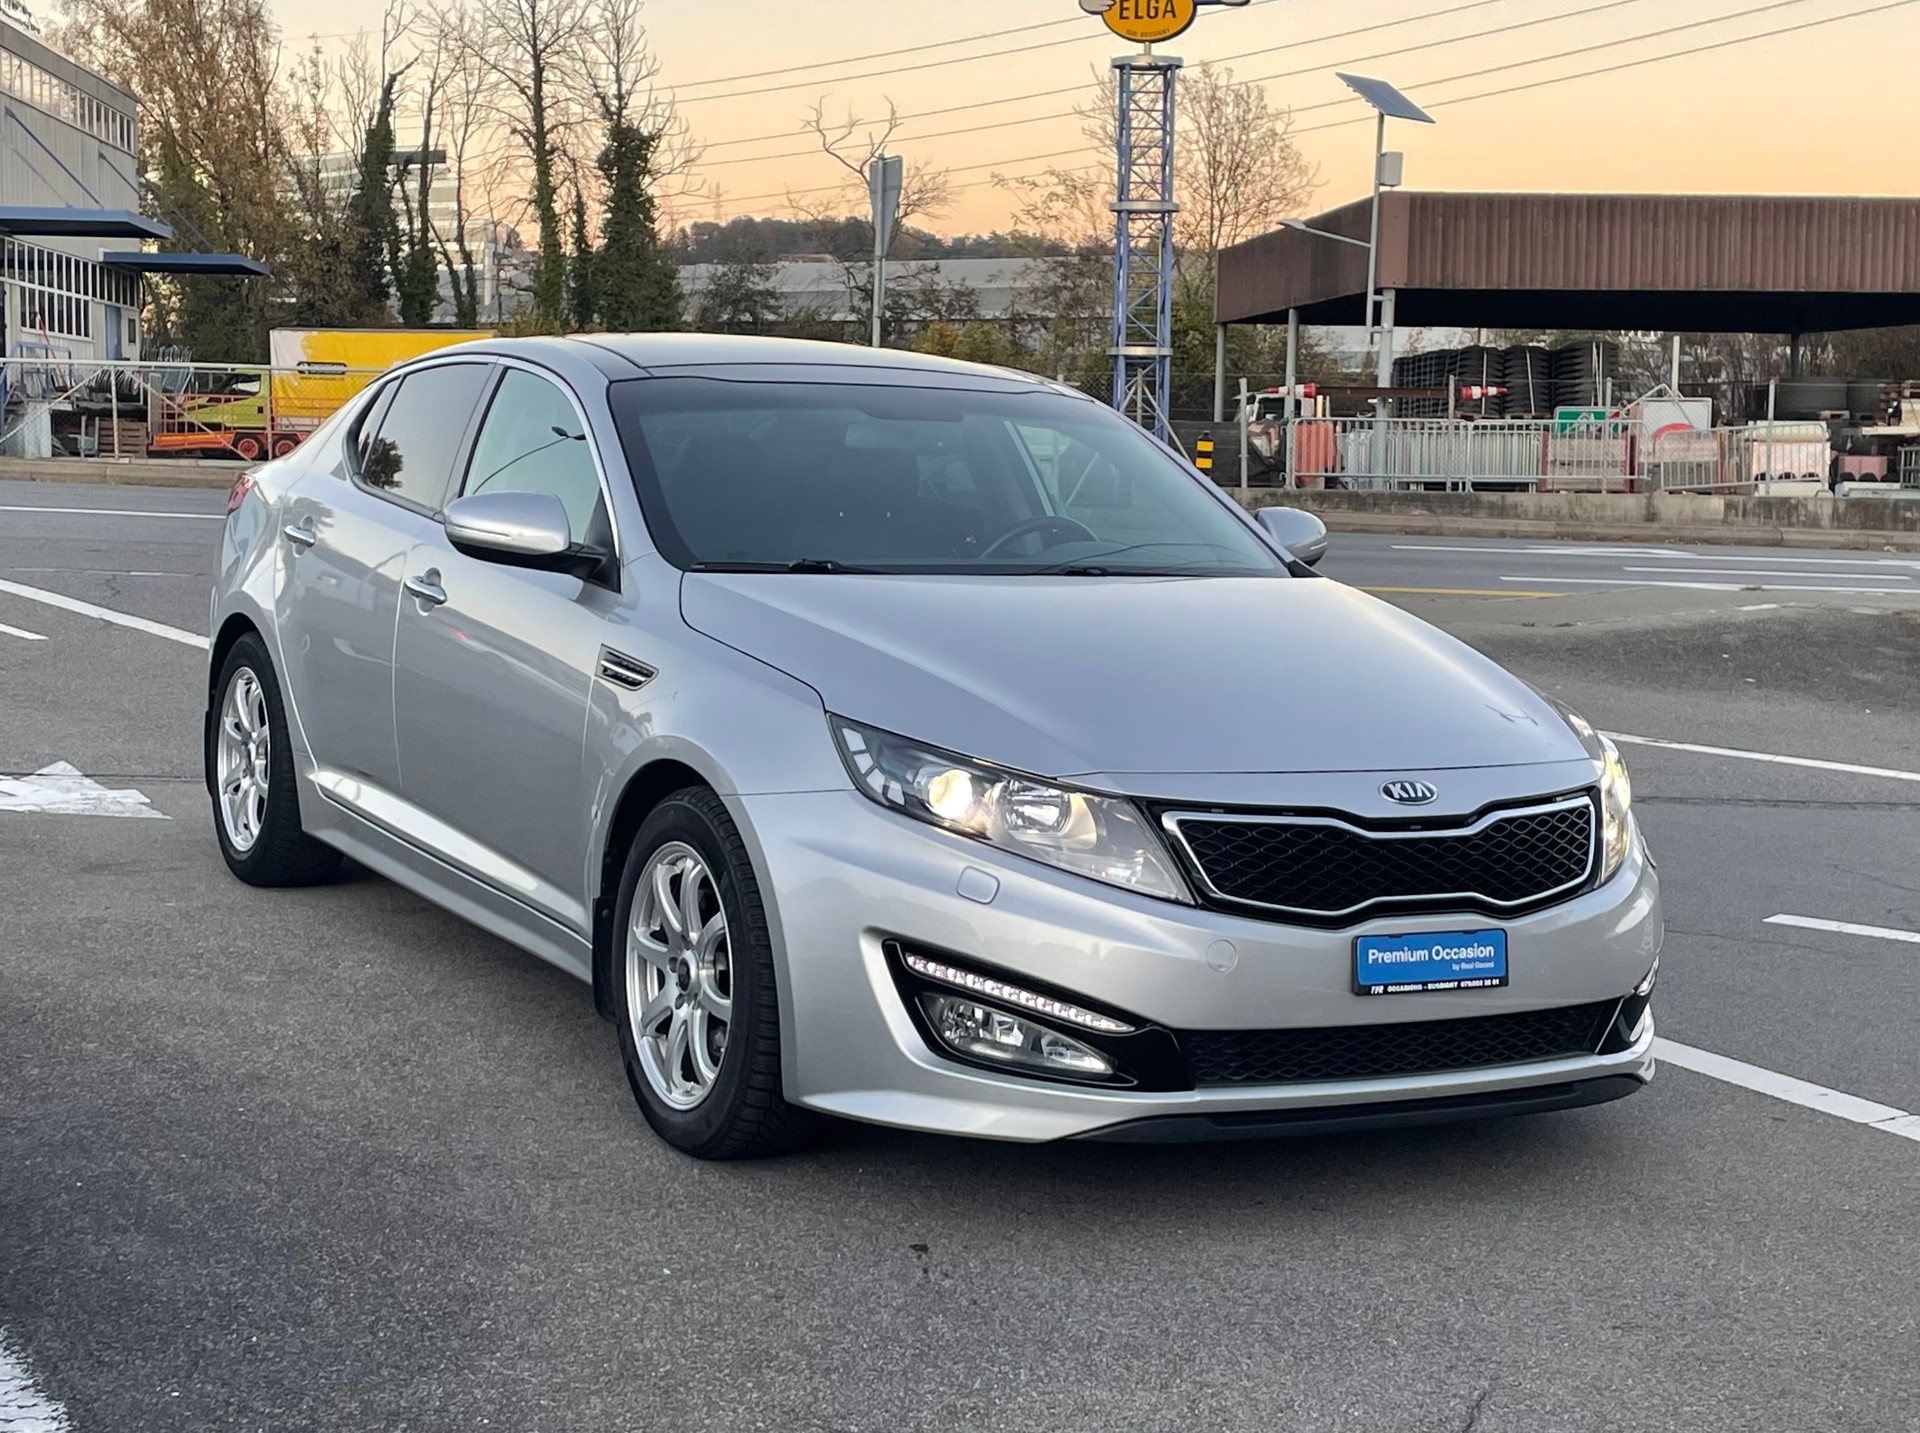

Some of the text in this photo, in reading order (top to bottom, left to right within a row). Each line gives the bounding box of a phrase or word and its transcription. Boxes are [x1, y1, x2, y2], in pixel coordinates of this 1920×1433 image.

[1119, 0, 1177, 20] ELGA
[1386, 782, 1432, 799] KIA
[1368, 942, 1495, 964] Premium Occasion
